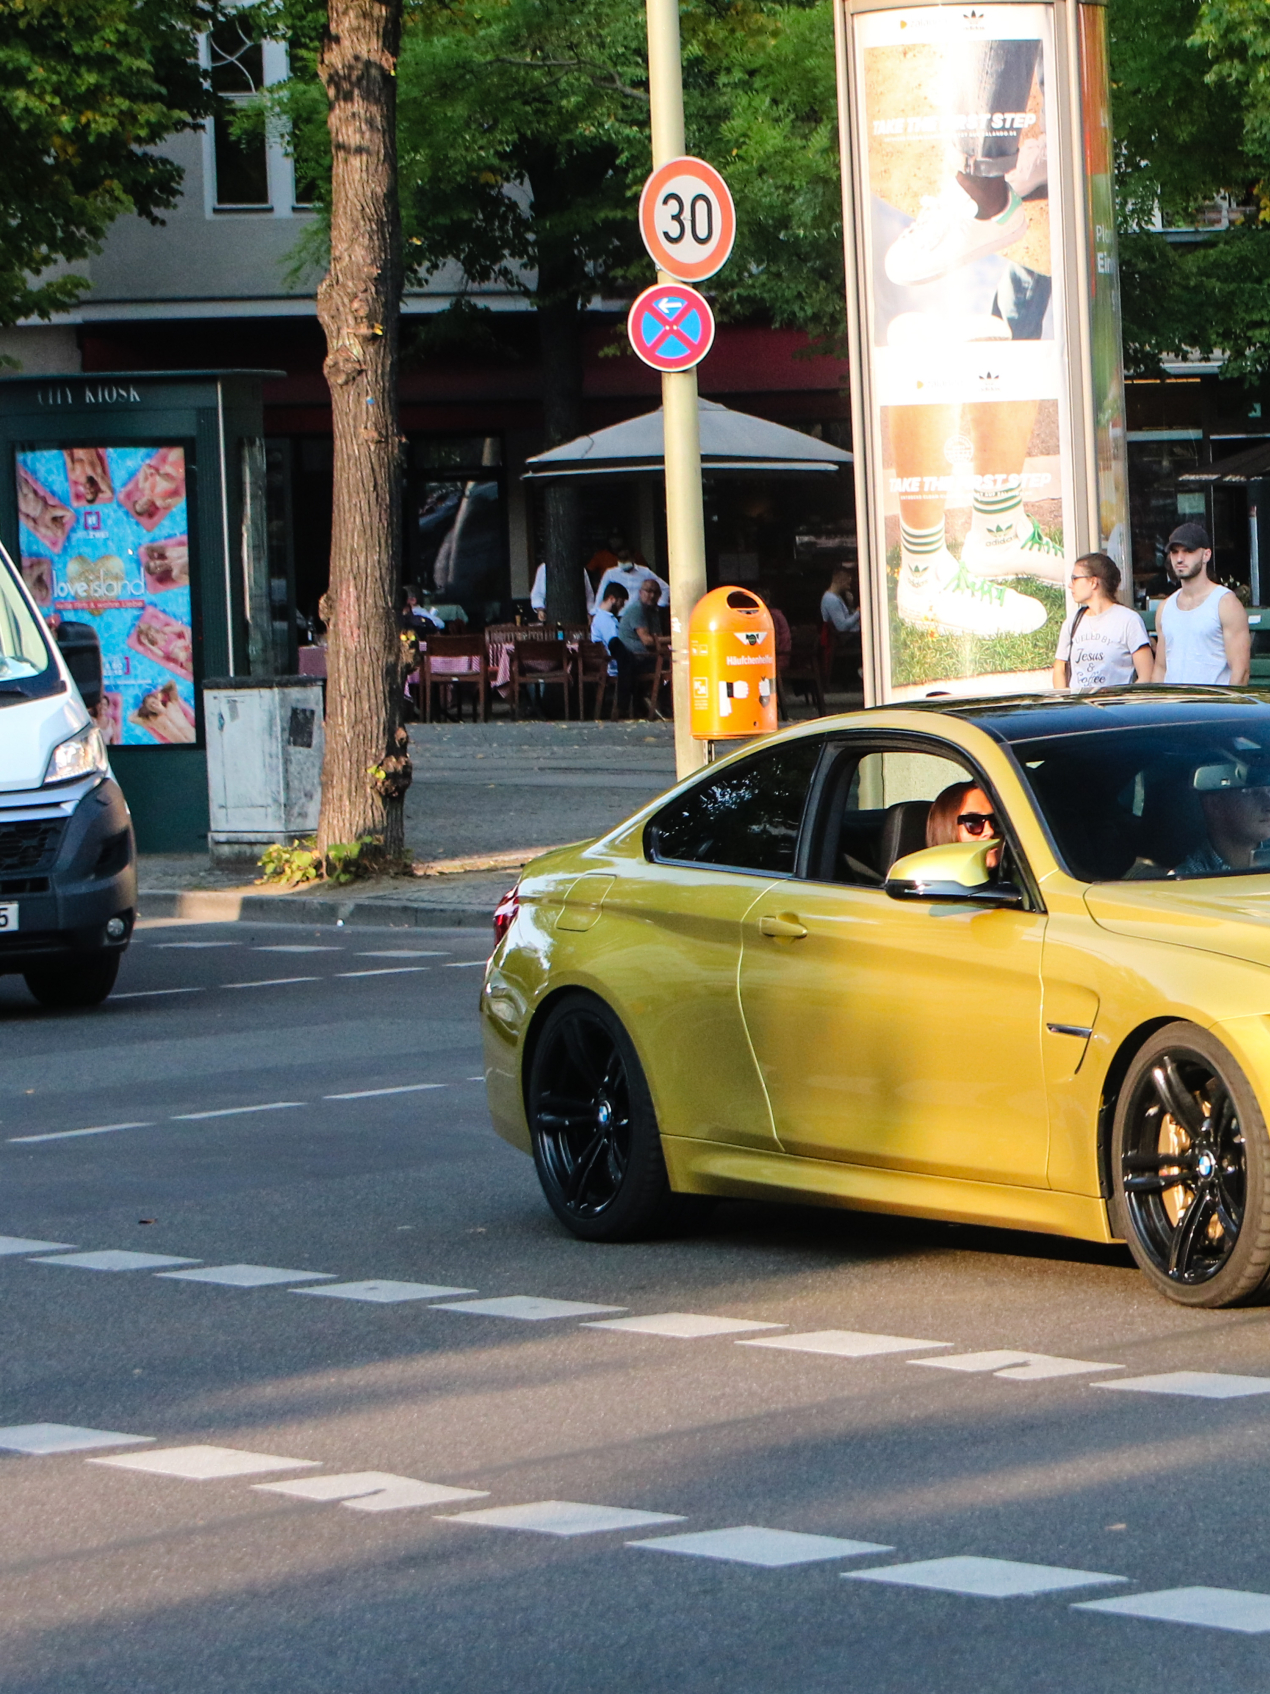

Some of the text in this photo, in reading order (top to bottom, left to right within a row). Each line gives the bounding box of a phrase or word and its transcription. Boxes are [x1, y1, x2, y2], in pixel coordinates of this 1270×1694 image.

[873, 118, 906, 136] TAKE
[991, 112, 1037, 129] STEP
[662, 192, 713, 245] 30
[85, 385, 141, 403] KIOSK
[889, 478, 921, 493] TAKE
[1006, 473, 1052, 489] STEP
[52, 566, 145, 598] love island
[1075, 633, 1100, 644] UELED
[1075, 647, 1104, 664] Jesus
[1086, 663, 1095, 673] &
